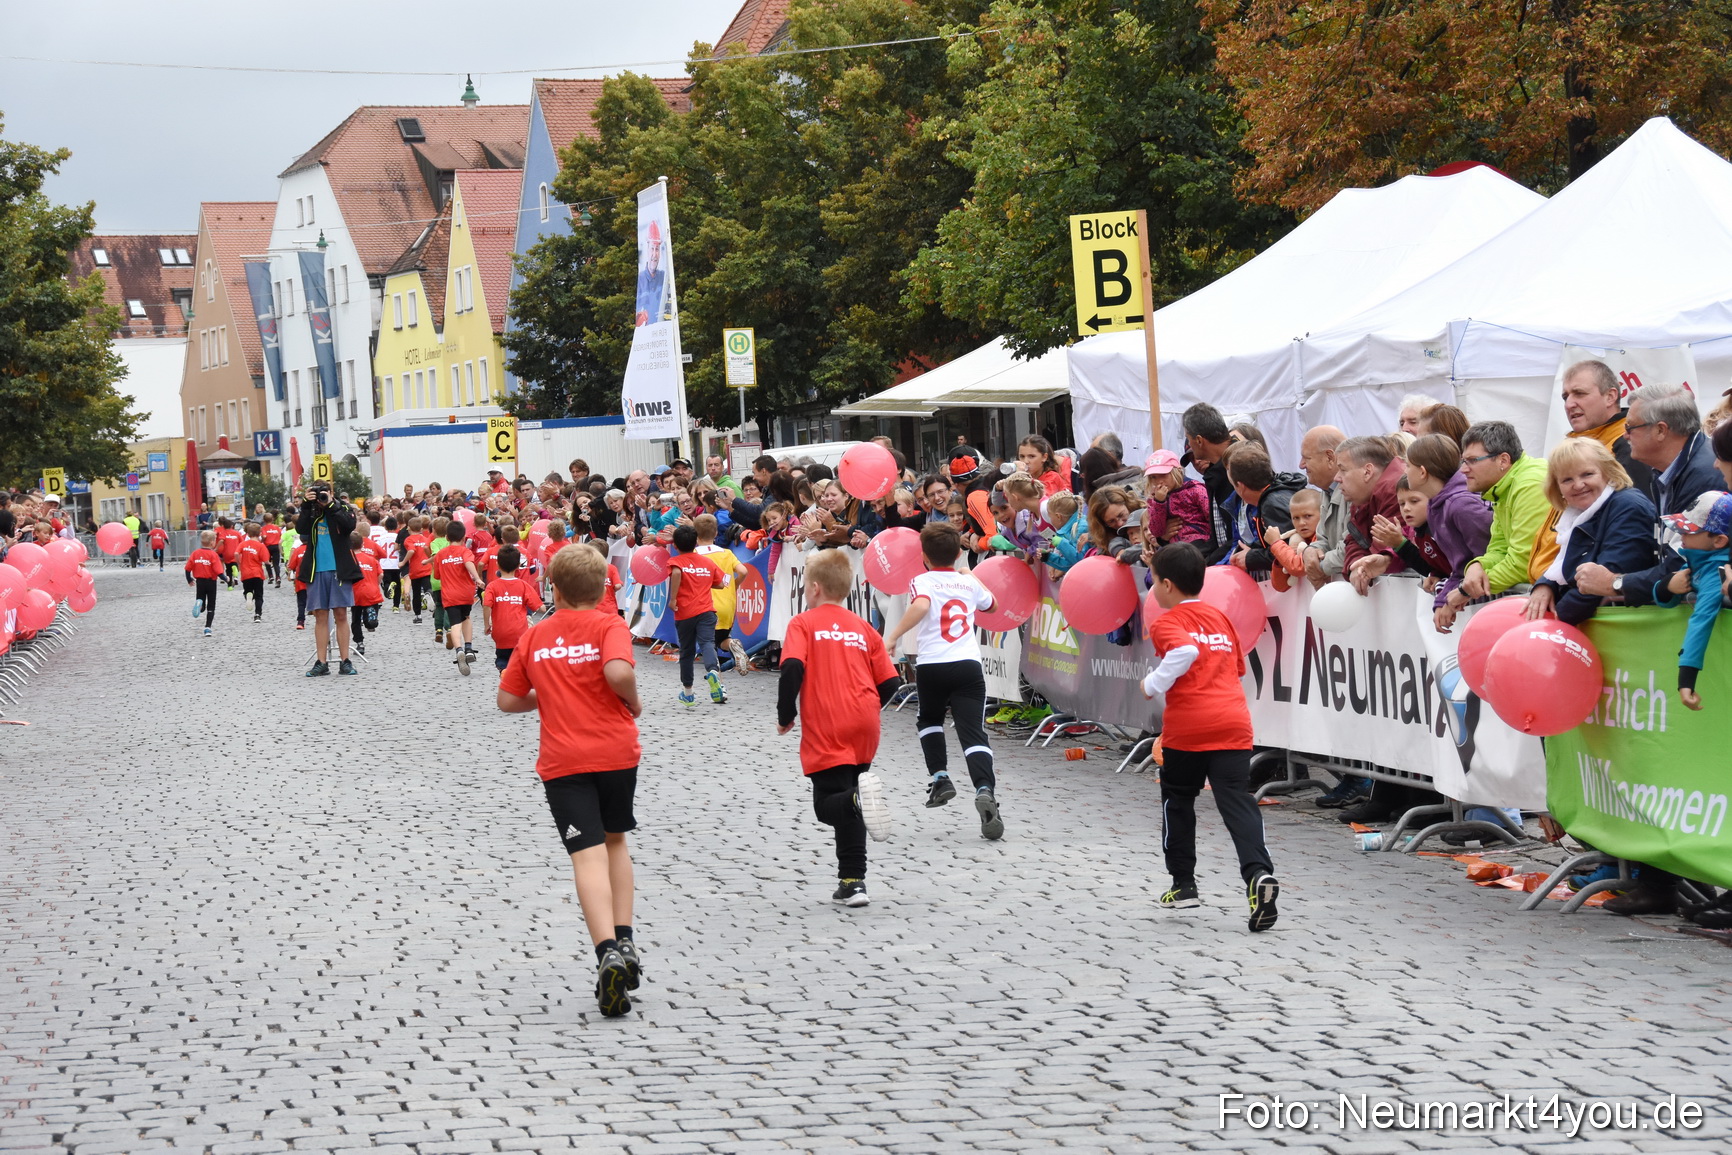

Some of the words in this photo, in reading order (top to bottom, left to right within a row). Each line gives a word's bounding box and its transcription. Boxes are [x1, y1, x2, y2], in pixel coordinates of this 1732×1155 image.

[1080, 216, 1138, 240] Block
[1093, 249, 1132, 307] B
[404, 348, 421, 366] HOTEL
[491, 420, 514, 428] Block
[495, 431, 510, 453] C
[319, 463, 328, 478] D
[49, 477, 60, 492] D
[940, 599, 970, 643] 6
[568, 653, 600, 665] energie
[1564, 647, 1591, 667] energie
